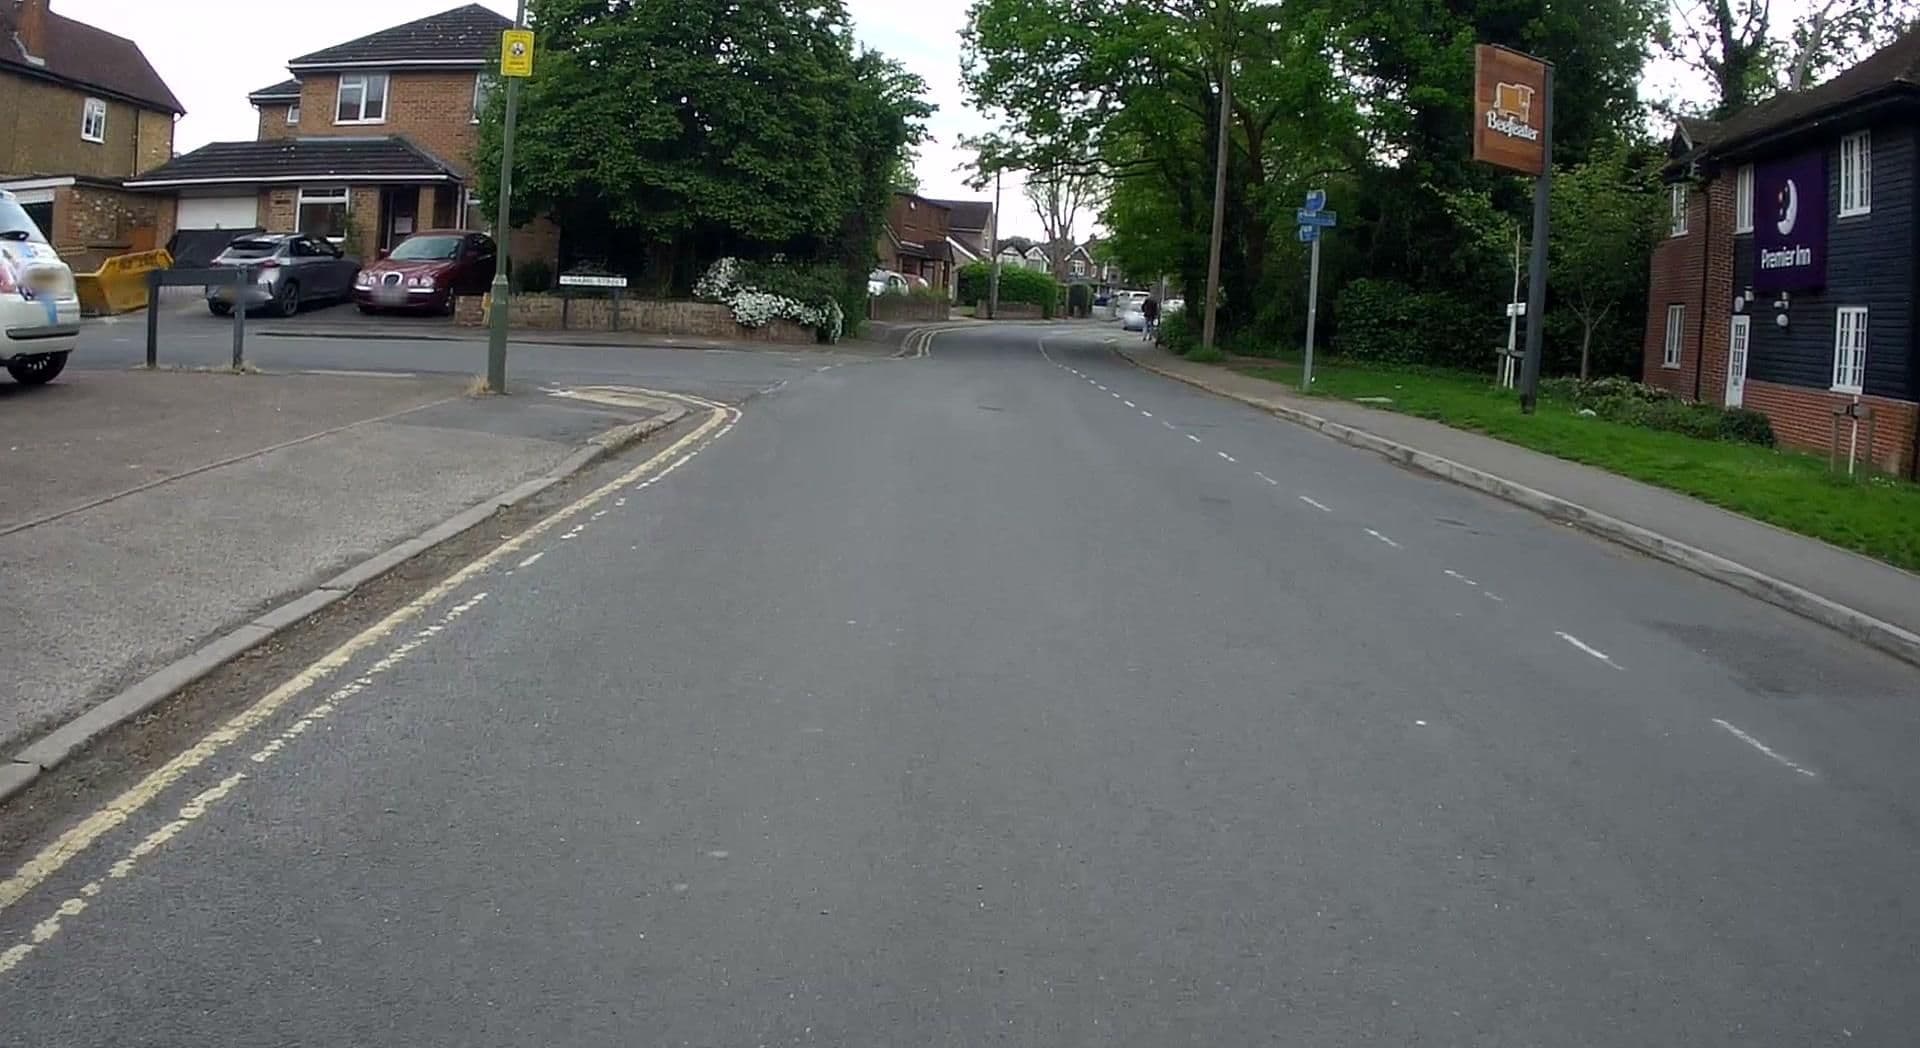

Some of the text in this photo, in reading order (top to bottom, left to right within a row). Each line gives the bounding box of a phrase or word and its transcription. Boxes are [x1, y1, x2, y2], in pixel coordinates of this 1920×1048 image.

[1487, 111, 1538, 140] Beefeater
[1761, 244, 1811, 269] Premier Inn
